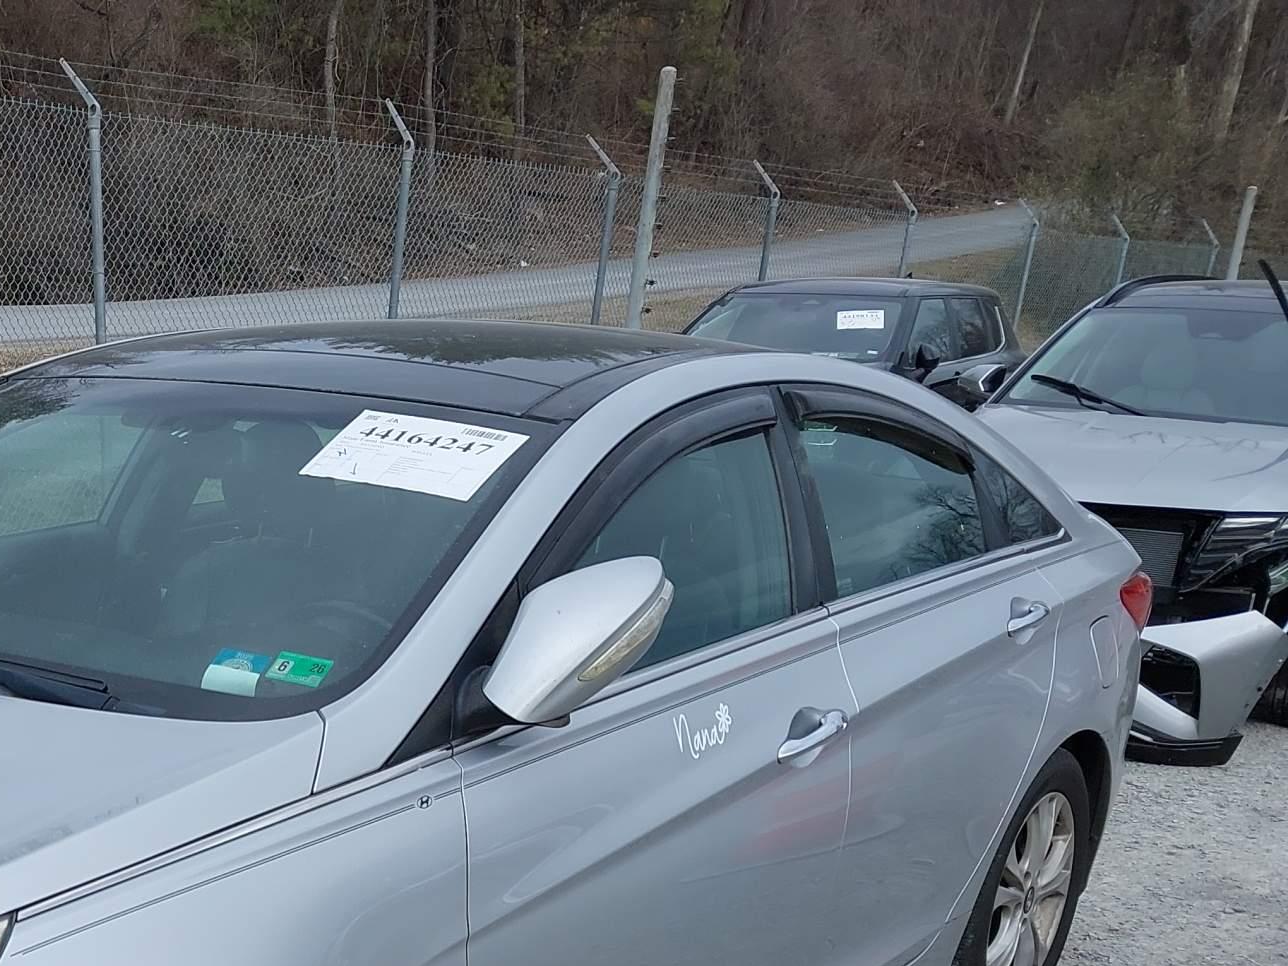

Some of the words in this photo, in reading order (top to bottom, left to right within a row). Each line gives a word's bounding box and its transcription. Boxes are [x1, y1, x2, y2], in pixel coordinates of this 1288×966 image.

[359, 426, 495, 456] 44164247
[277, 660, 290, 673] 6
[310, 663, 327, 675] 26
[672, 713, 726, 760] Nana
